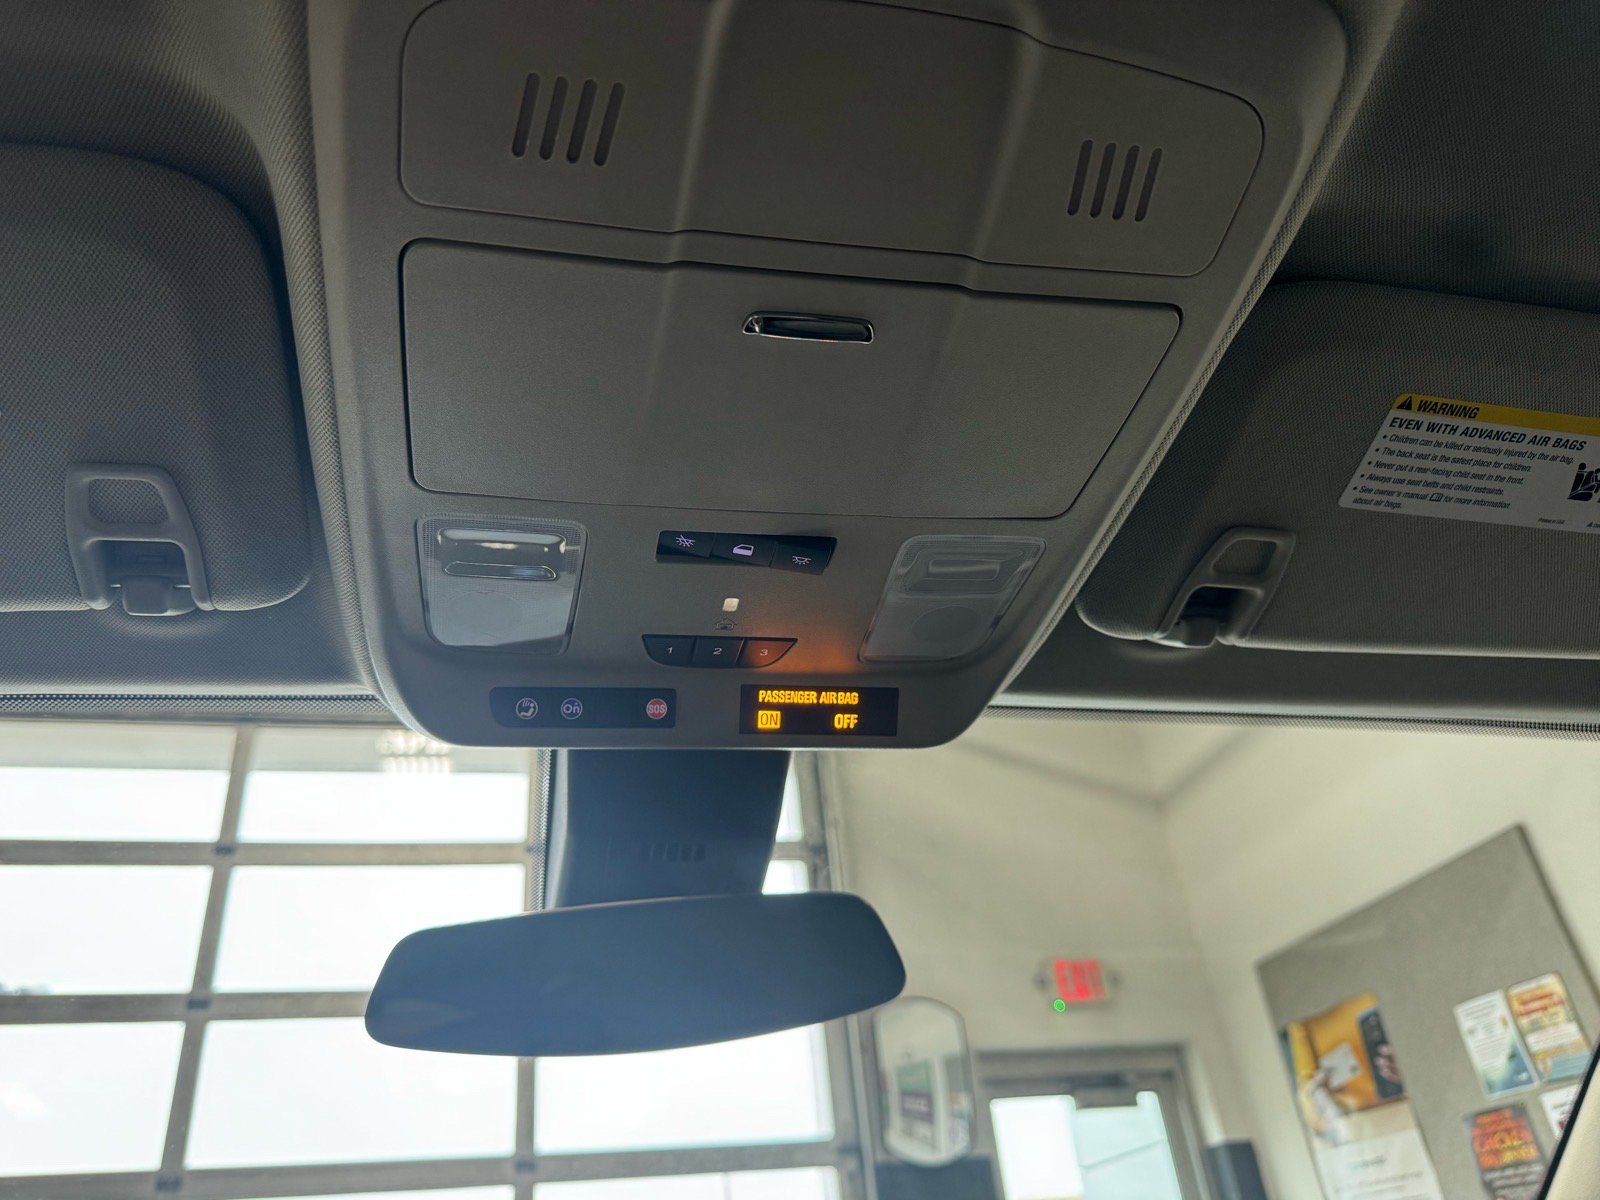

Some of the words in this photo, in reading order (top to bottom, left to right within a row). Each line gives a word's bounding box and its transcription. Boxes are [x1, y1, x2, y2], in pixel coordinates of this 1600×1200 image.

[1416, 400, 1480, 420] WARNING
[1389, 417, 1424, 431] EVEN
[1426, 421, 1460, 436] WITH
[1459, 426, 1527, 443] ADVANCED
[1527, 435, 1551, 447] AIR
[1552, 437, 1587, 451] BAGS
[1389, 434, 1419, 445] Children
[1420, 439, 1433, 447] can
[1433, 440, 1444, 448] be
[1443, 441, 1464, 451] killed
[1471, 446, 1504, 456] seriously
[1503, 447, 1527, 459] injured
[1527, 450, 1538, 460] by
[1538, 452, 1550, 461] the
[1549, 454, 1559, 462] air
[1559, 455, 1574, 465] bag.
[1382, 447, 1396, 456] The
[1396, 449, 1413, 459] back
[1413, 452, 1431, 460] seat
[1438, 454, 1451, 463] the
[1450, 457, 1473, 466] safest
[1471, 458, 1492, 468] place
[1491, 460, 1503, 469] for
[1373, 460, 1394, 470] Never
[1394, 463, 1409, 472] put
[1414, 466, 1453, 478] rear-facing
[1452, 469, 1471, 479] child
[1469, 472, 1487, 481] seat
[1486, 473, 1494, 481] in
[1493, 474, 1507, 483] the
[1366, 473, 1391, 484] Always
[1392, 477, 1406, 485] use
[1406, 478, 1423, 487] seat
[1422, 480, 1440, 488] belts
[1439, 481, 1455, 490] and
[1453, 483, 1472, 492] child
[1352, 497, 1374, 506] about
[1359, 485, 1374, 494] See
[1373, 488, 1402, 498] owner's
[1402, 491, 1430, 501] manual
[1443, 495, 1454, 503] for
[1454, 497, 1473, 506] more
[1472, 498, 1511, 509] information
[712, 647, 723, 655] 2
[759, 648, 769, 657] 3
[758, 690, 818, 704] PASSENGER
[562, 702, 580, 714] On
[647, 703, 666, 714] SOS
[760, 712, 779, 726] ON
[834, 713, 858, 729] OFF
